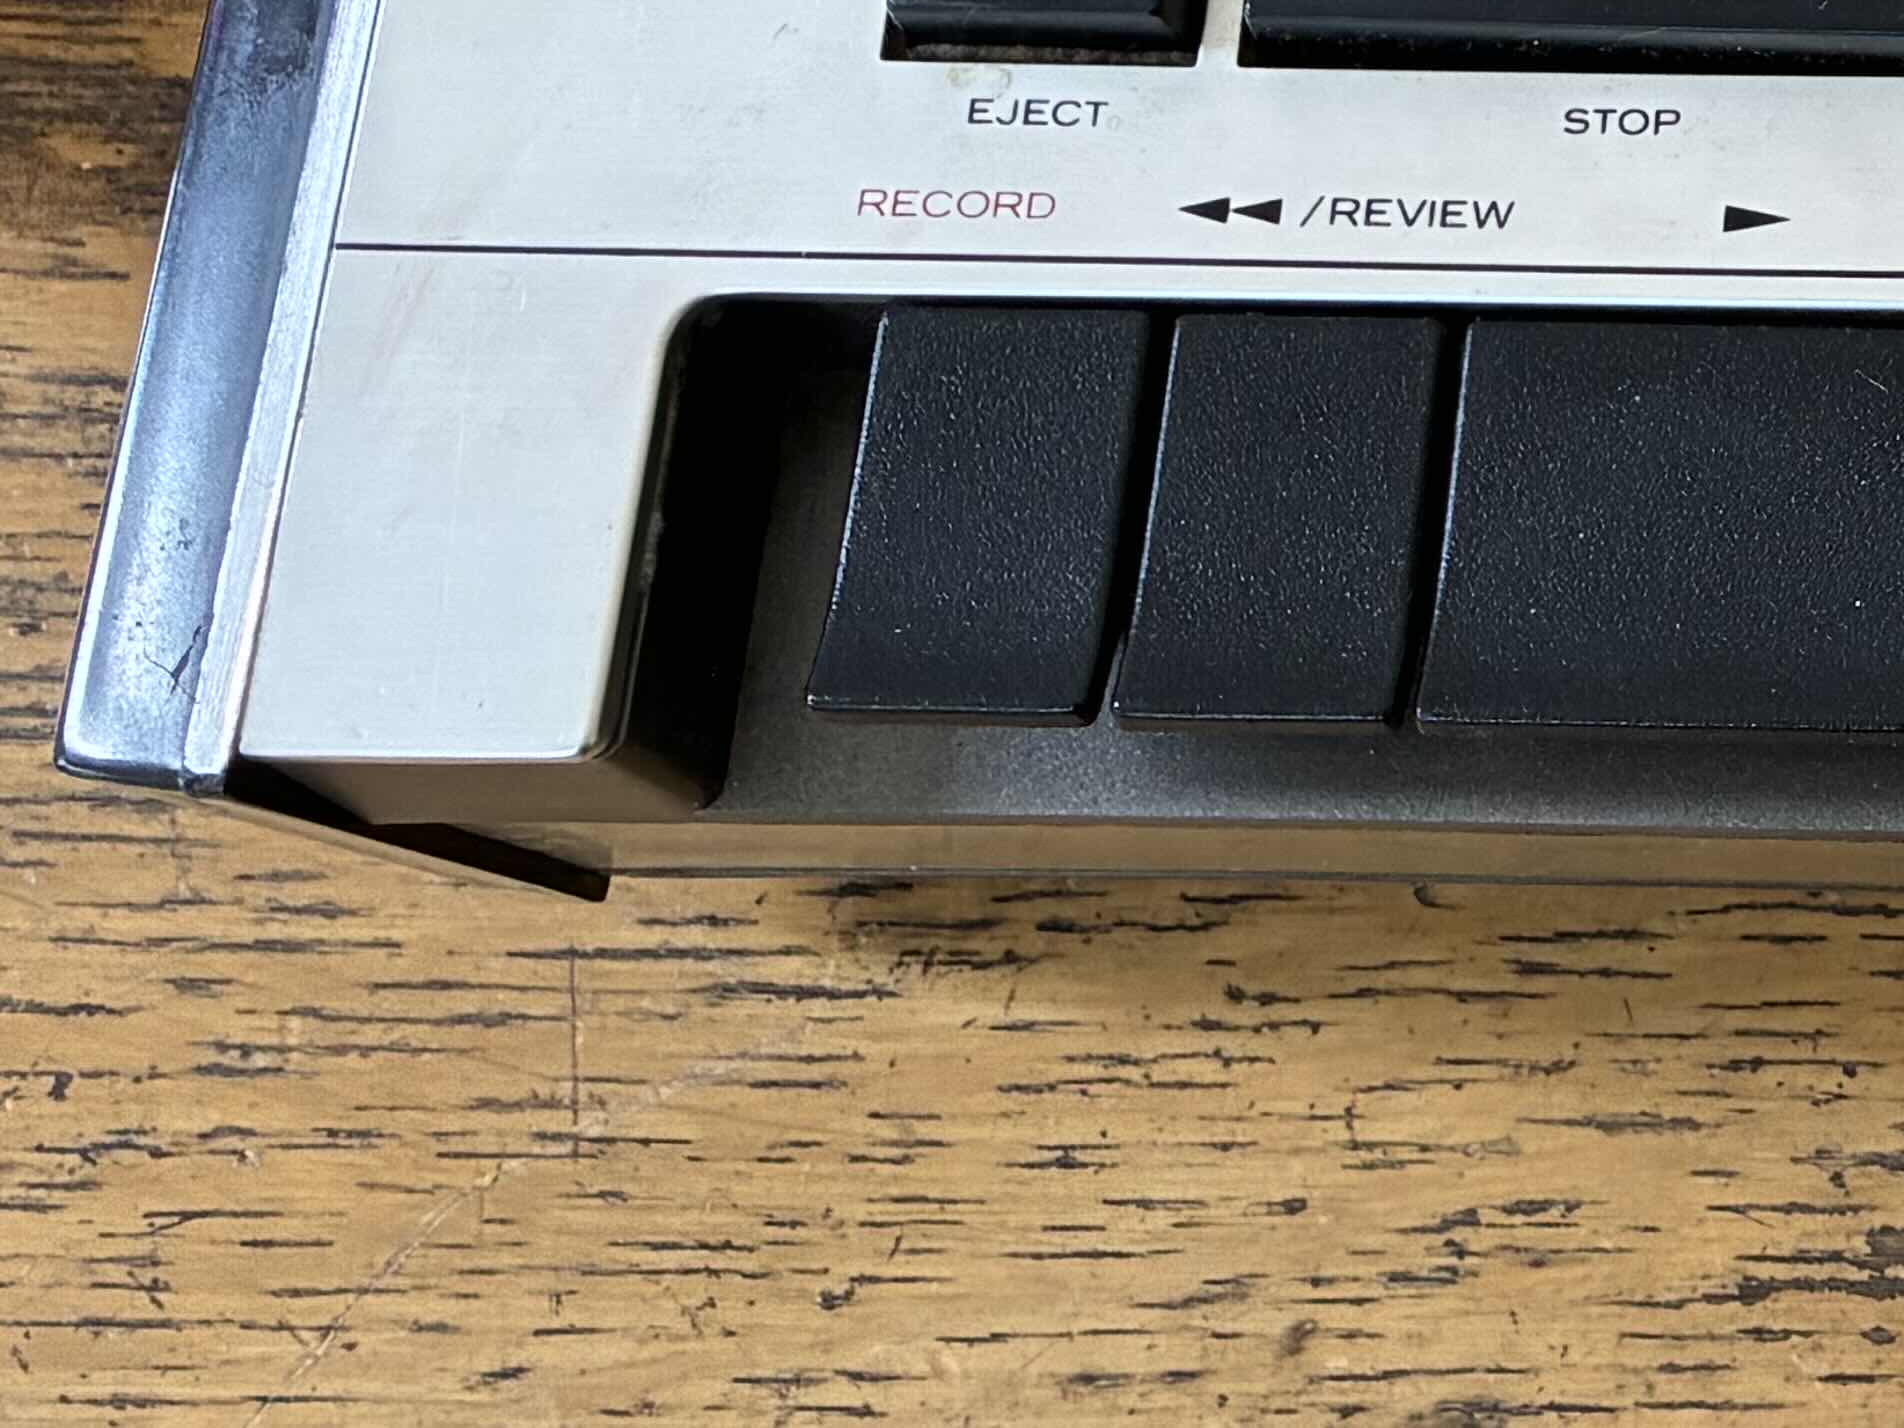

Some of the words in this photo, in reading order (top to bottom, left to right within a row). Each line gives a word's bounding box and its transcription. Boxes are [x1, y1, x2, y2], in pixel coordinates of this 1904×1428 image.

[967, 98, 1109, 127] EJECT
[1563, 108, 1681, 136] STOP
[857, 189, 1056, 219] RECORD
